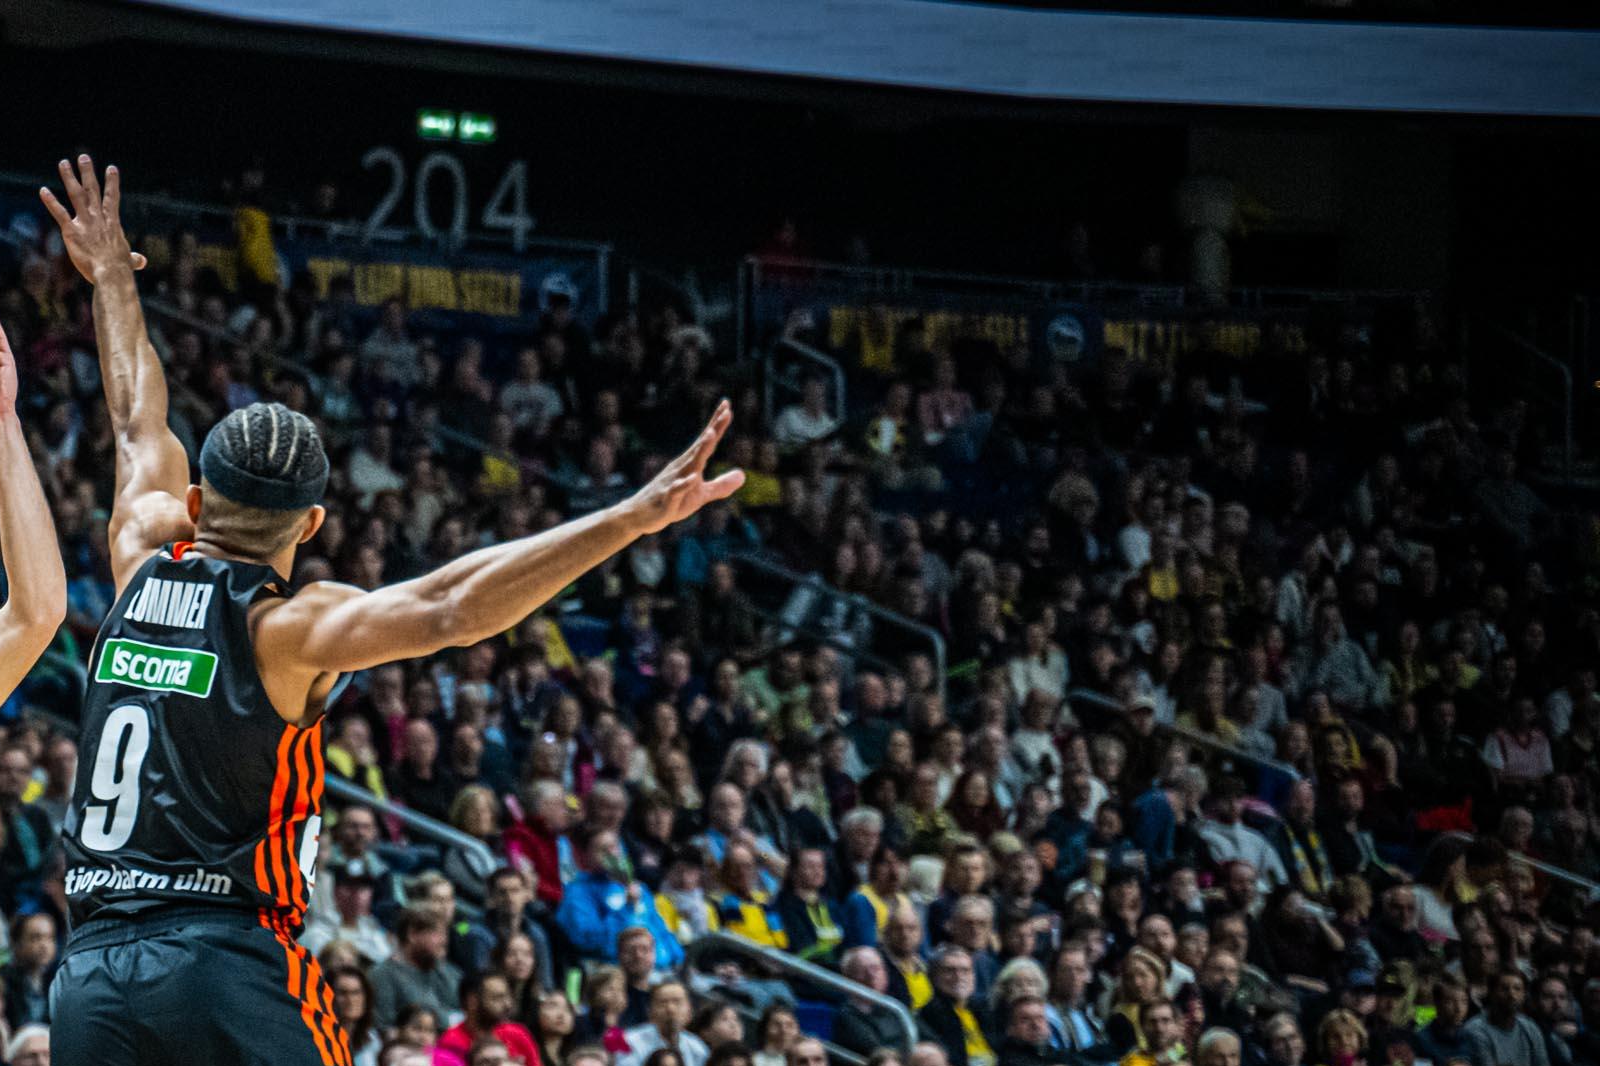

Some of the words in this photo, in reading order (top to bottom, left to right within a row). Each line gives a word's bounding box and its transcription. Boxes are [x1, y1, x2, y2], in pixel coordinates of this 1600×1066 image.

[360, 145, 536, 254] 204
[80, 704, 150, 852] 9
[172, 867, 233, 894] ulm
